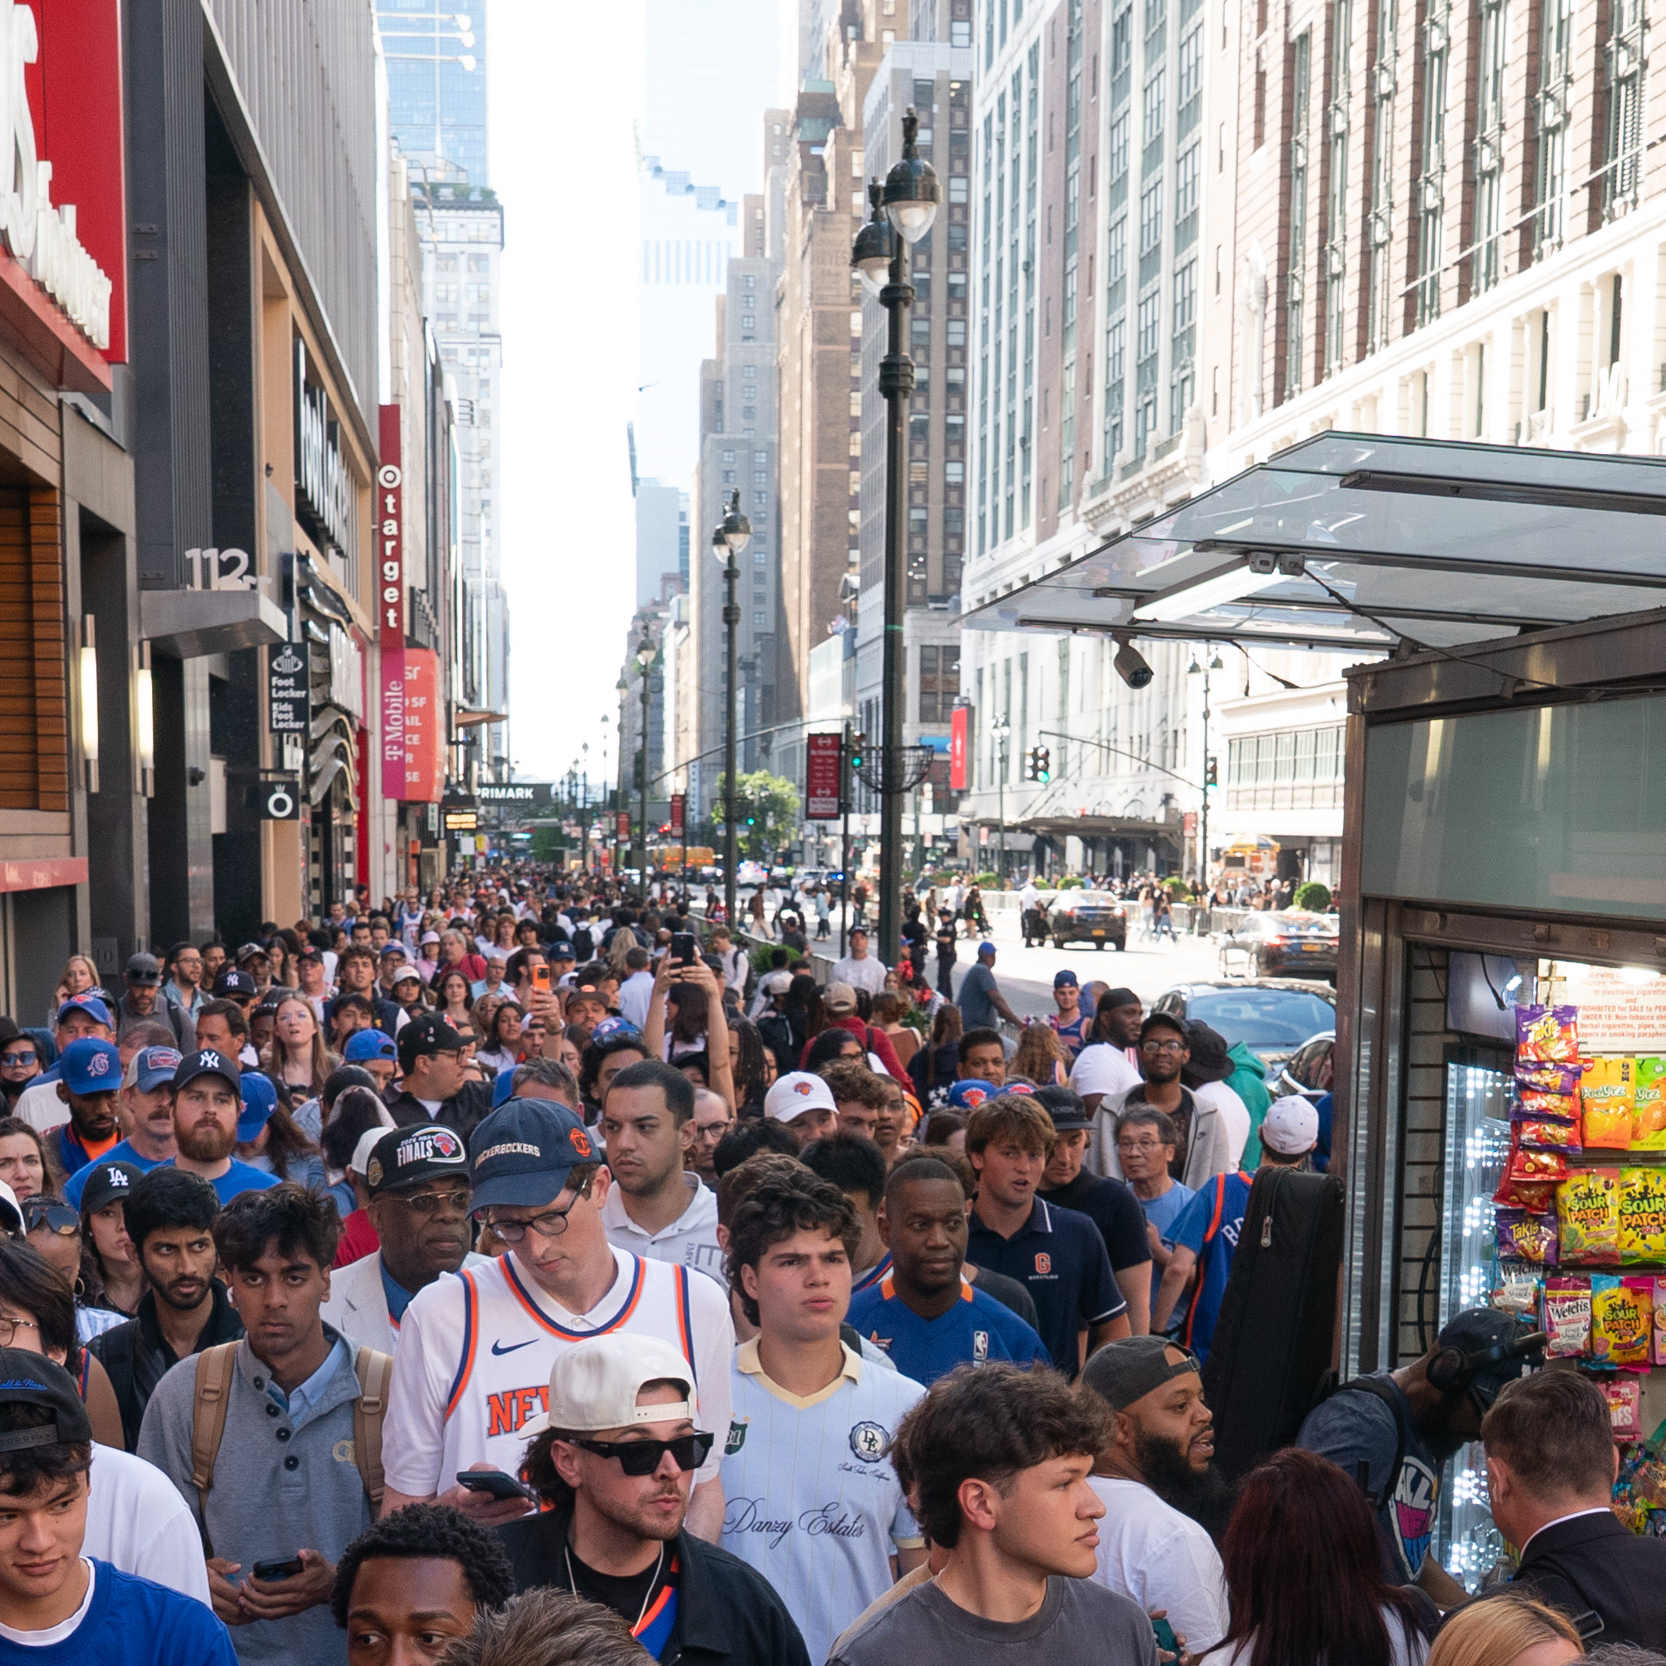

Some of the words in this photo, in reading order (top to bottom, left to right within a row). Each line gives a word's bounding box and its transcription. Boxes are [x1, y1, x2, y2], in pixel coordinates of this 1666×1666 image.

[382, 494, 400, 629] target
[271, 677, 295, 687] Foot
[271, 687, 307, 698] Locker
[272, 711, 294, 720] Foot
[272, 719, 306, 729] Locker
[396, 1140, 433, 1167] FINALS
[107, 1167, 129, 1187] LA
[1570, 1196, 1607, 1211] SOUR
[1622, 1199, 1666, 1214] SOUR
[1569, 1207, 1610, 1224] PATCH
[1035, 1252, 1051, 1274] G
[1603, 1308, 1638, 1320] SOUR
[1603, 1319, 1641, 1333] PATCH
